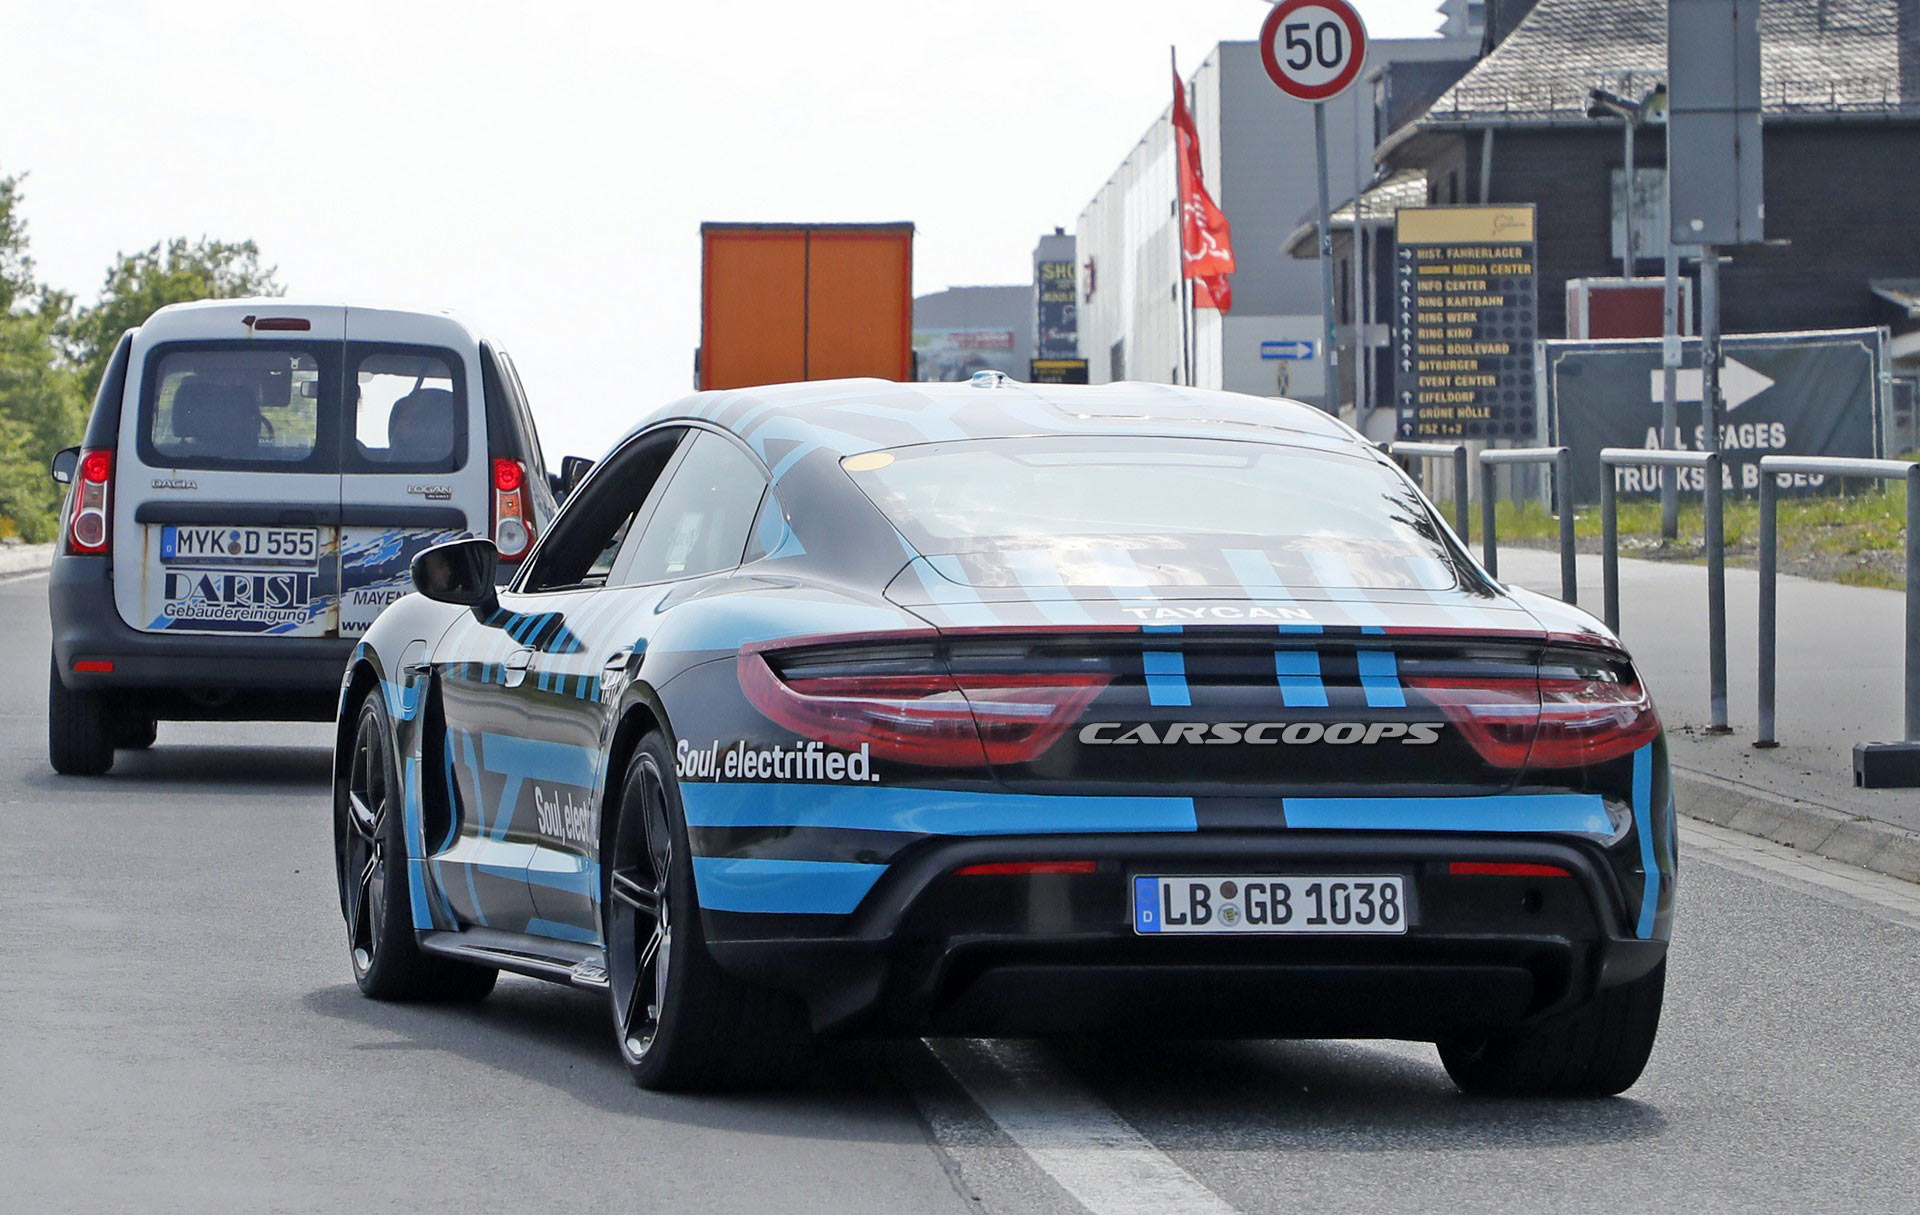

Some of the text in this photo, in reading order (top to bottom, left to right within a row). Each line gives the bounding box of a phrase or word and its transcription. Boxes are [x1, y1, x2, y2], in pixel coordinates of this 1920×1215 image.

[1285, 21, 1343, 71] 50
[1447, 247, 1522, 259] FAHRERLAGER
[1453, 264, 1532, 275] MEDIA CENTER
[1418, 281, 1486, 291] INFO CENTER
[1418, 296, 1504, 307] RING KARTBAHN
[1418, 312, 1477, 323] RING WERK
[1418, 328, 1472, 339] RING KINO
[1418, 343, 1509, 355] RING BOULEVARD
[1418, 359, 1478, 370] BITBURGER
[1419, 375, 1496, 387] EVENT CENTER
[1419, 391, 1476, 403] EIFELDORF
[1419, 406, 1490, 419] GRÜNE HÖLLE
[151, 479, 197, 489] DACIA
[407, 486, 452, 494] LOGAN
[177, 530, 226, 553] MYK
[245, 531, 260, 554] D
[267, 532, 314, 556] 555
[164, 602, 307, 624] Gebäudereinigung
[1123, 606, 1314, 620] TAYCAN
[676, 739, 880, 783] Soul, electrified.
[535, 786, 565, 846] Soul,
[1143, 883, 1400, 925] D LB GB 1038
